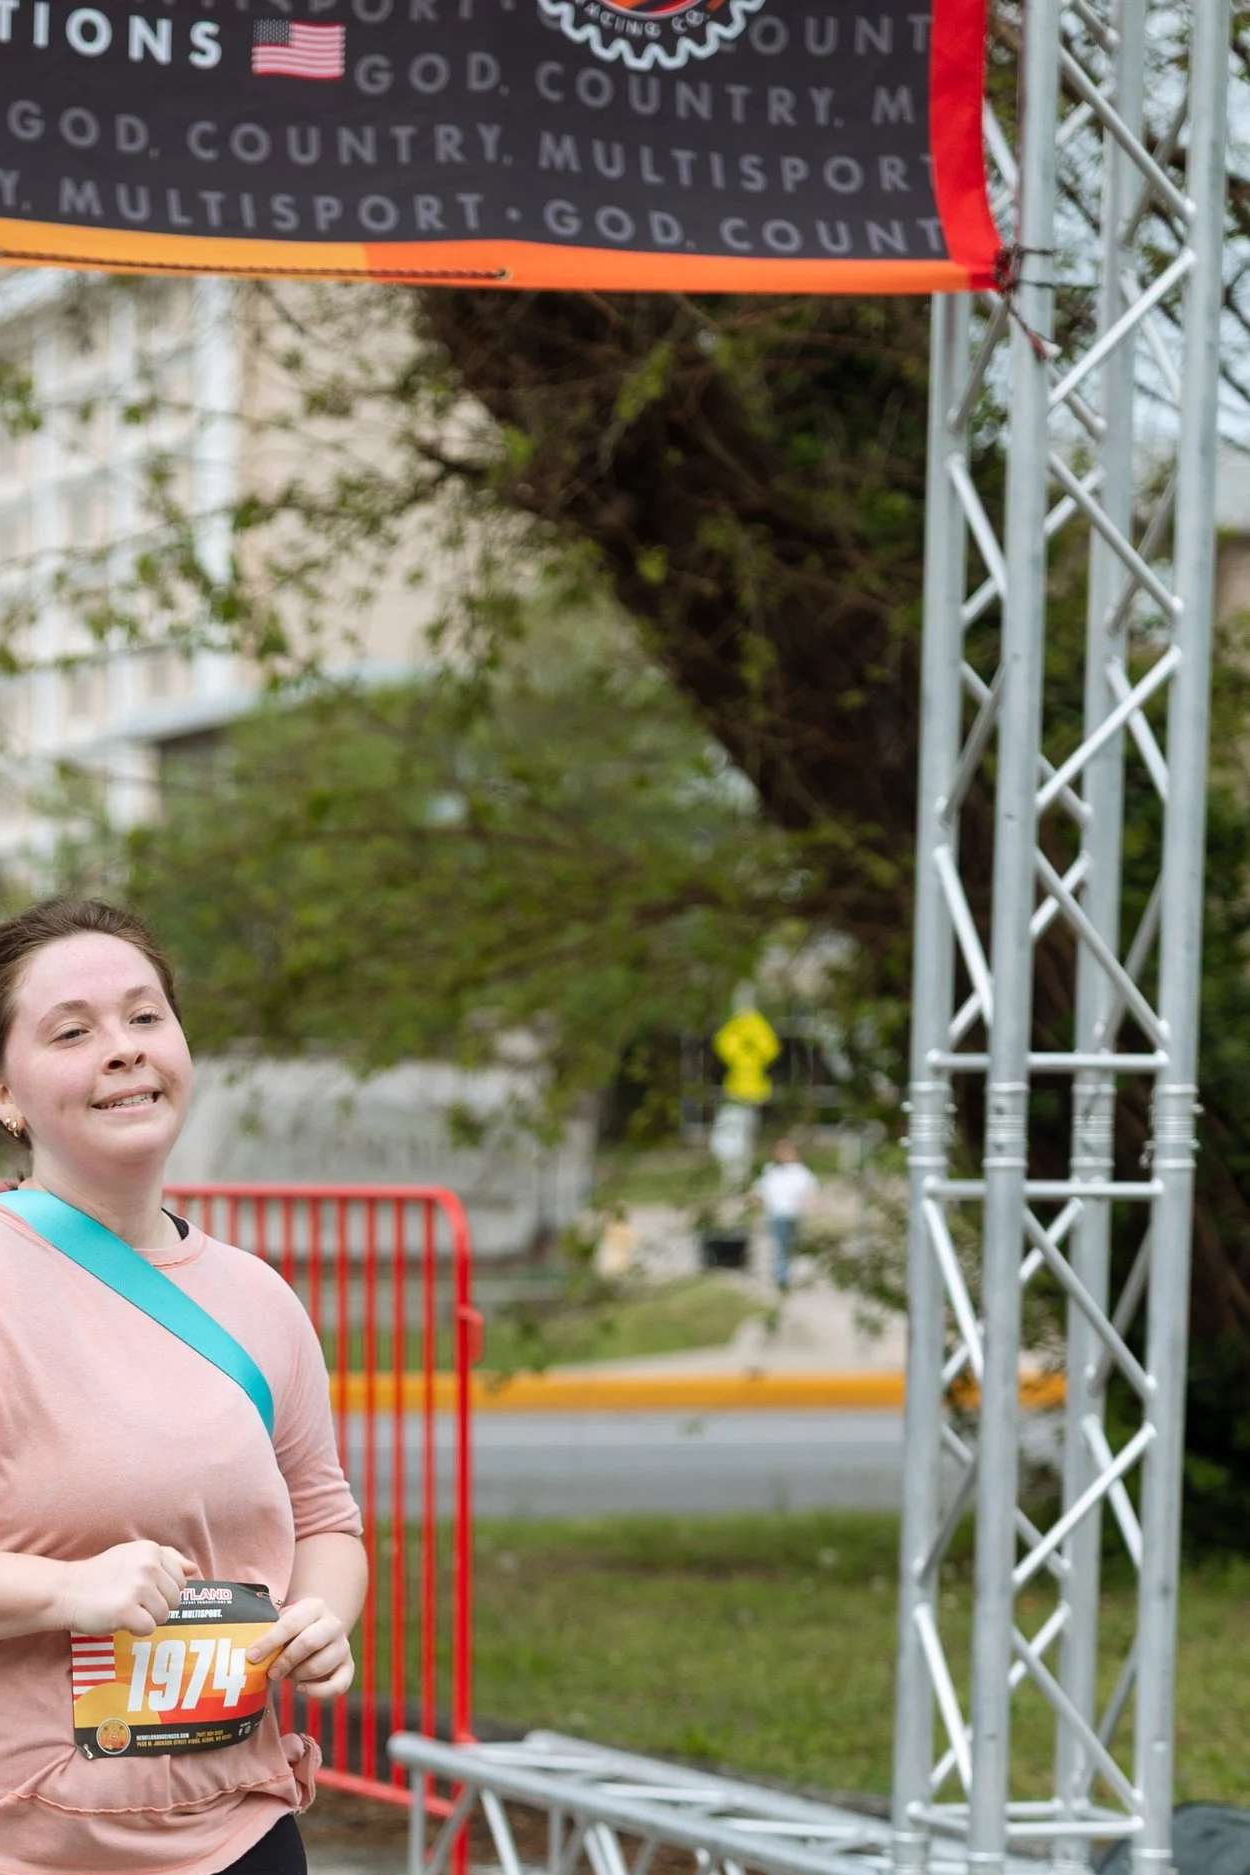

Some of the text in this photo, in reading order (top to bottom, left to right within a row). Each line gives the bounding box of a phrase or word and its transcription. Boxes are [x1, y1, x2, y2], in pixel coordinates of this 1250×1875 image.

[575, 0, 662, 38] ACING
[58, 176, 485, 233] MULTISPORT
[127, 1638, 247, 1712] 1974
